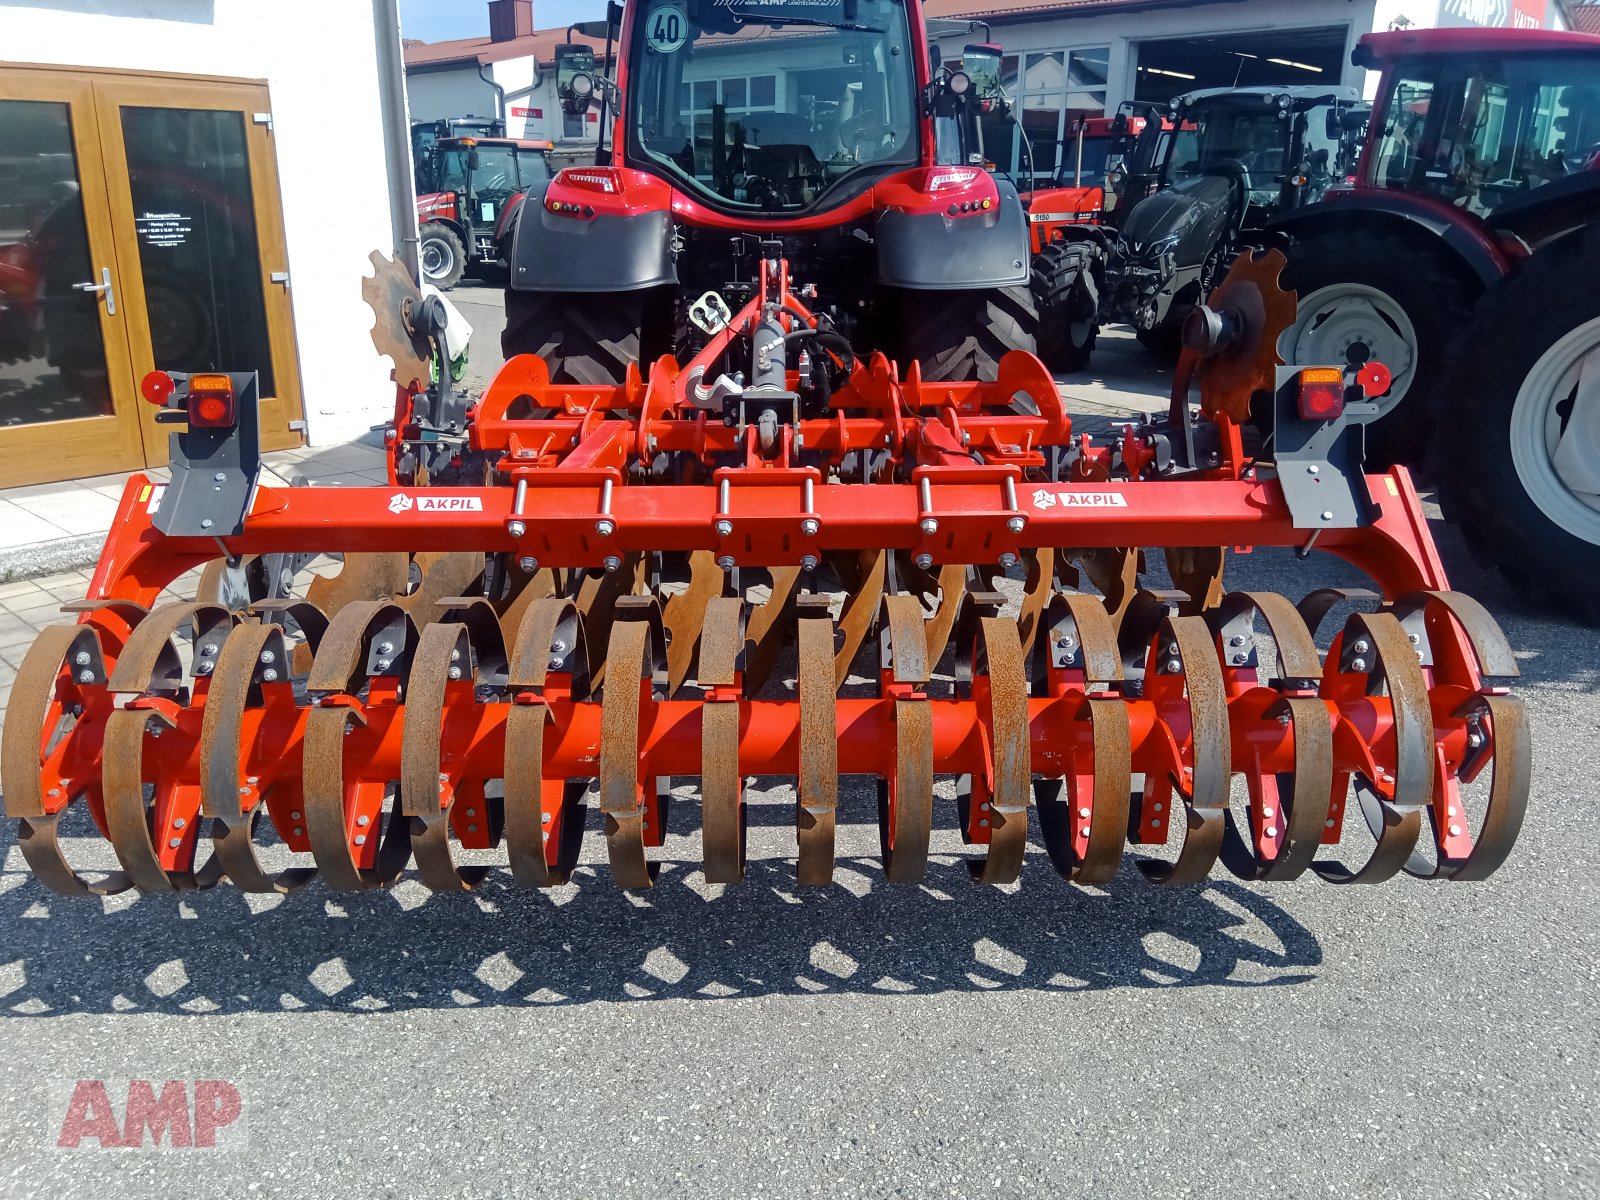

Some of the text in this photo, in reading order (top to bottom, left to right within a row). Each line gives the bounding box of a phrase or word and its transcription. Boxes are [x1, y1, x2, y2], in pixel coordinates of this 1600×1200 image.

[653, 14, 680, 44] 40
[1035, 213, 1050, 221] 5150
[422, 498, 476, 510] AKPIL
[1066, 494, 1120, 506] AKPIL
